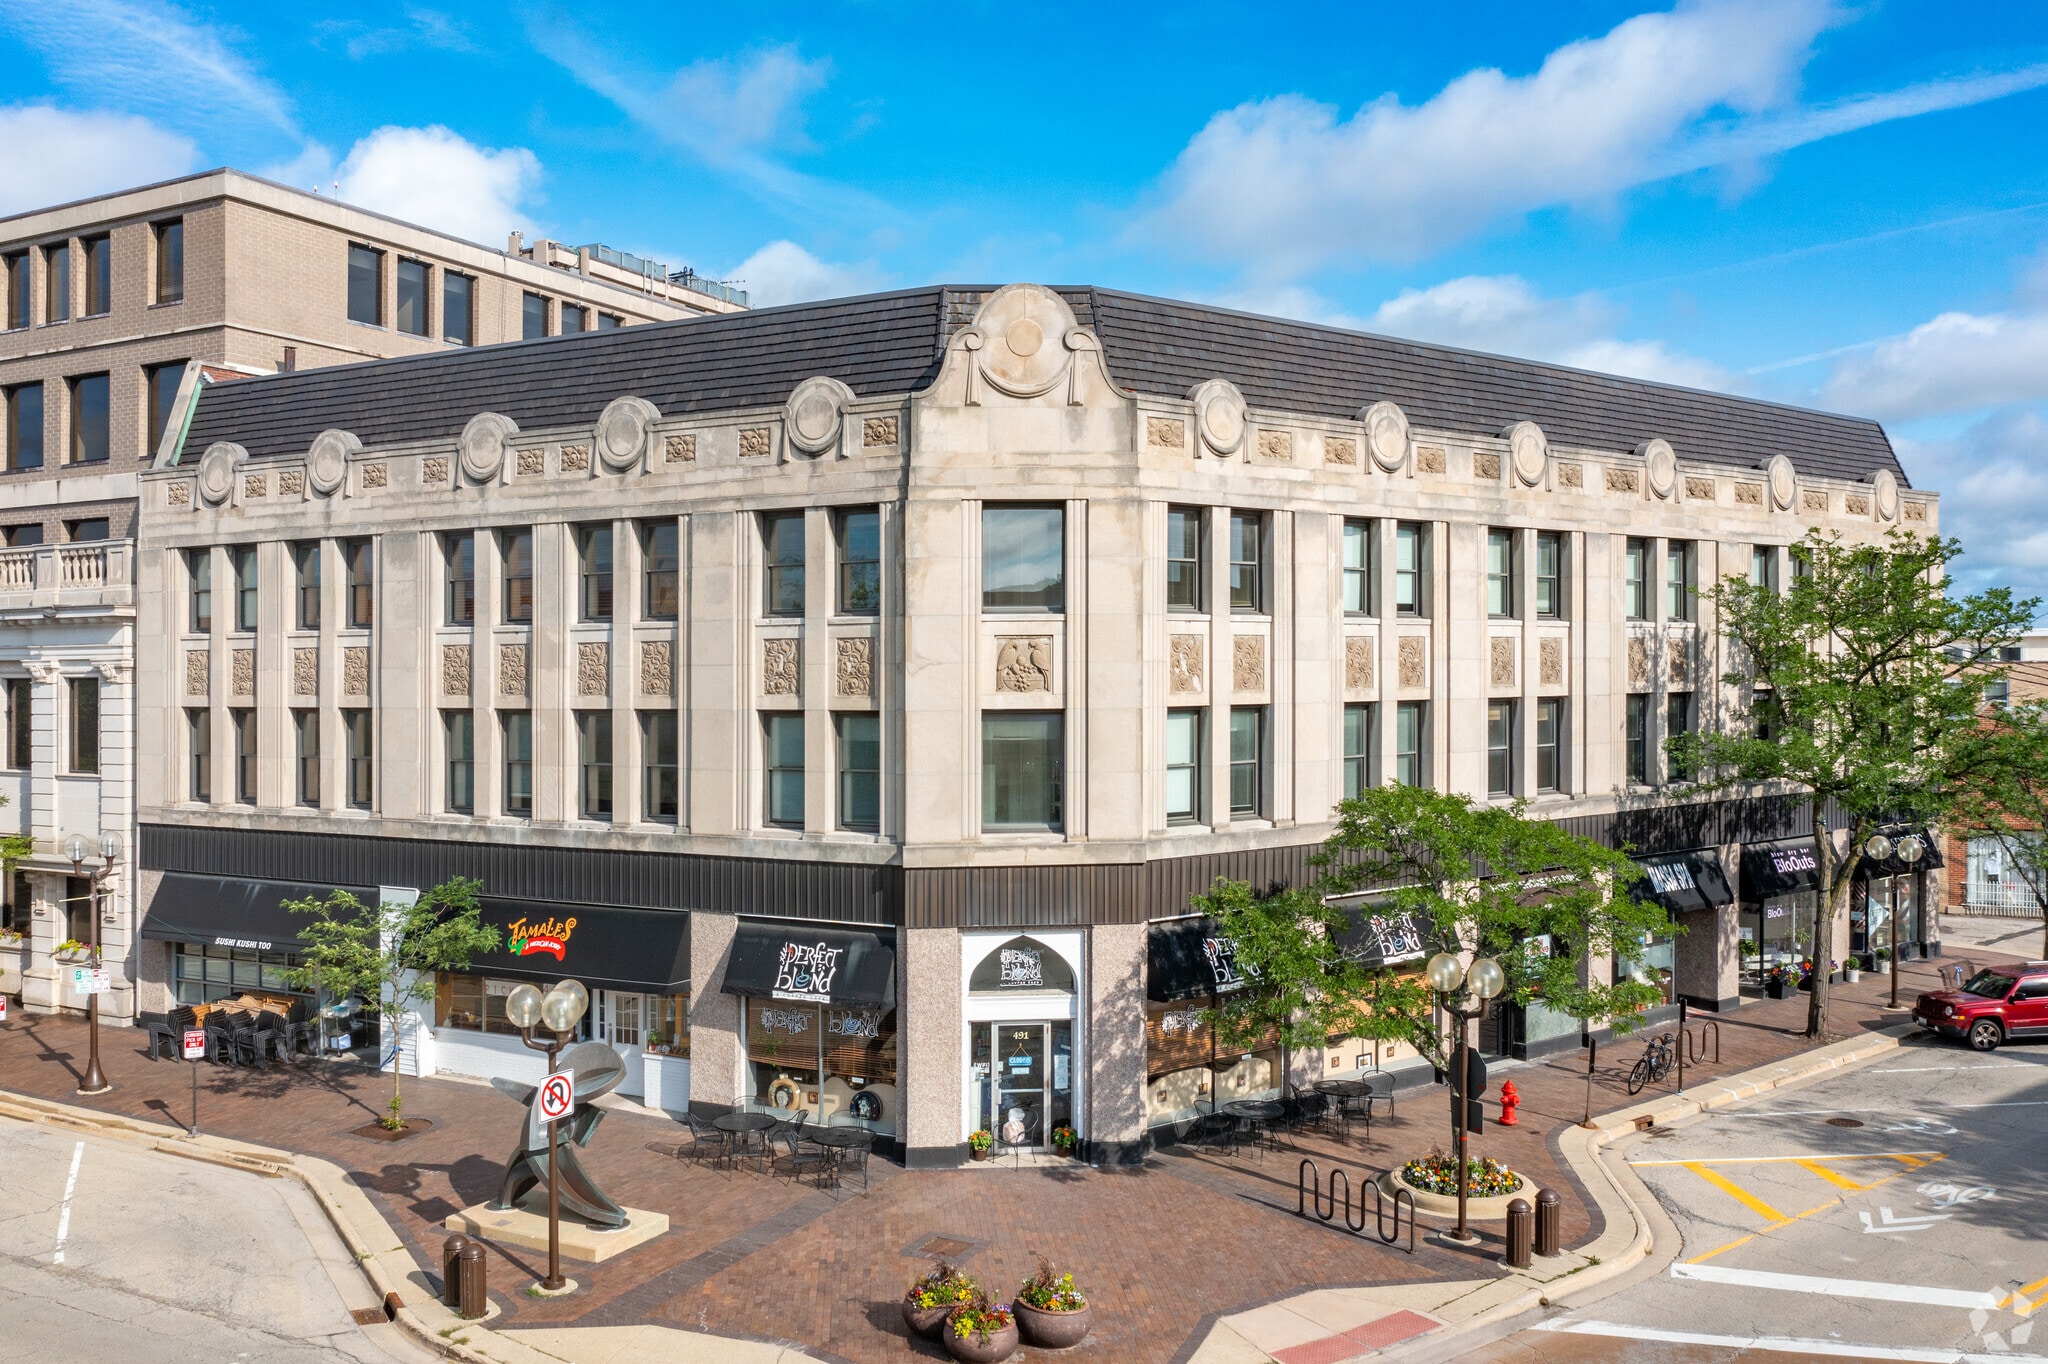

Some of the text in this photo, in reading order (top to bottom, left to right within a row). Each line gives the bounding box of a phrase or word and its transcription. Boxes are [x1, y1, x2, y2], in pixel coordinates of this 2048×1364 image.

[1773, 855, 1816, 873] BloOuts
[1647, 862, 1696, 893] MASSA SPA
[214, 937, 272, 950] SUSHI KUSHI TOO
[508, 917, 577, 952] TAMALES
[1162, 1004, 1208, 1037] PERf
[1013, 1031, 1029, 1040] 491
